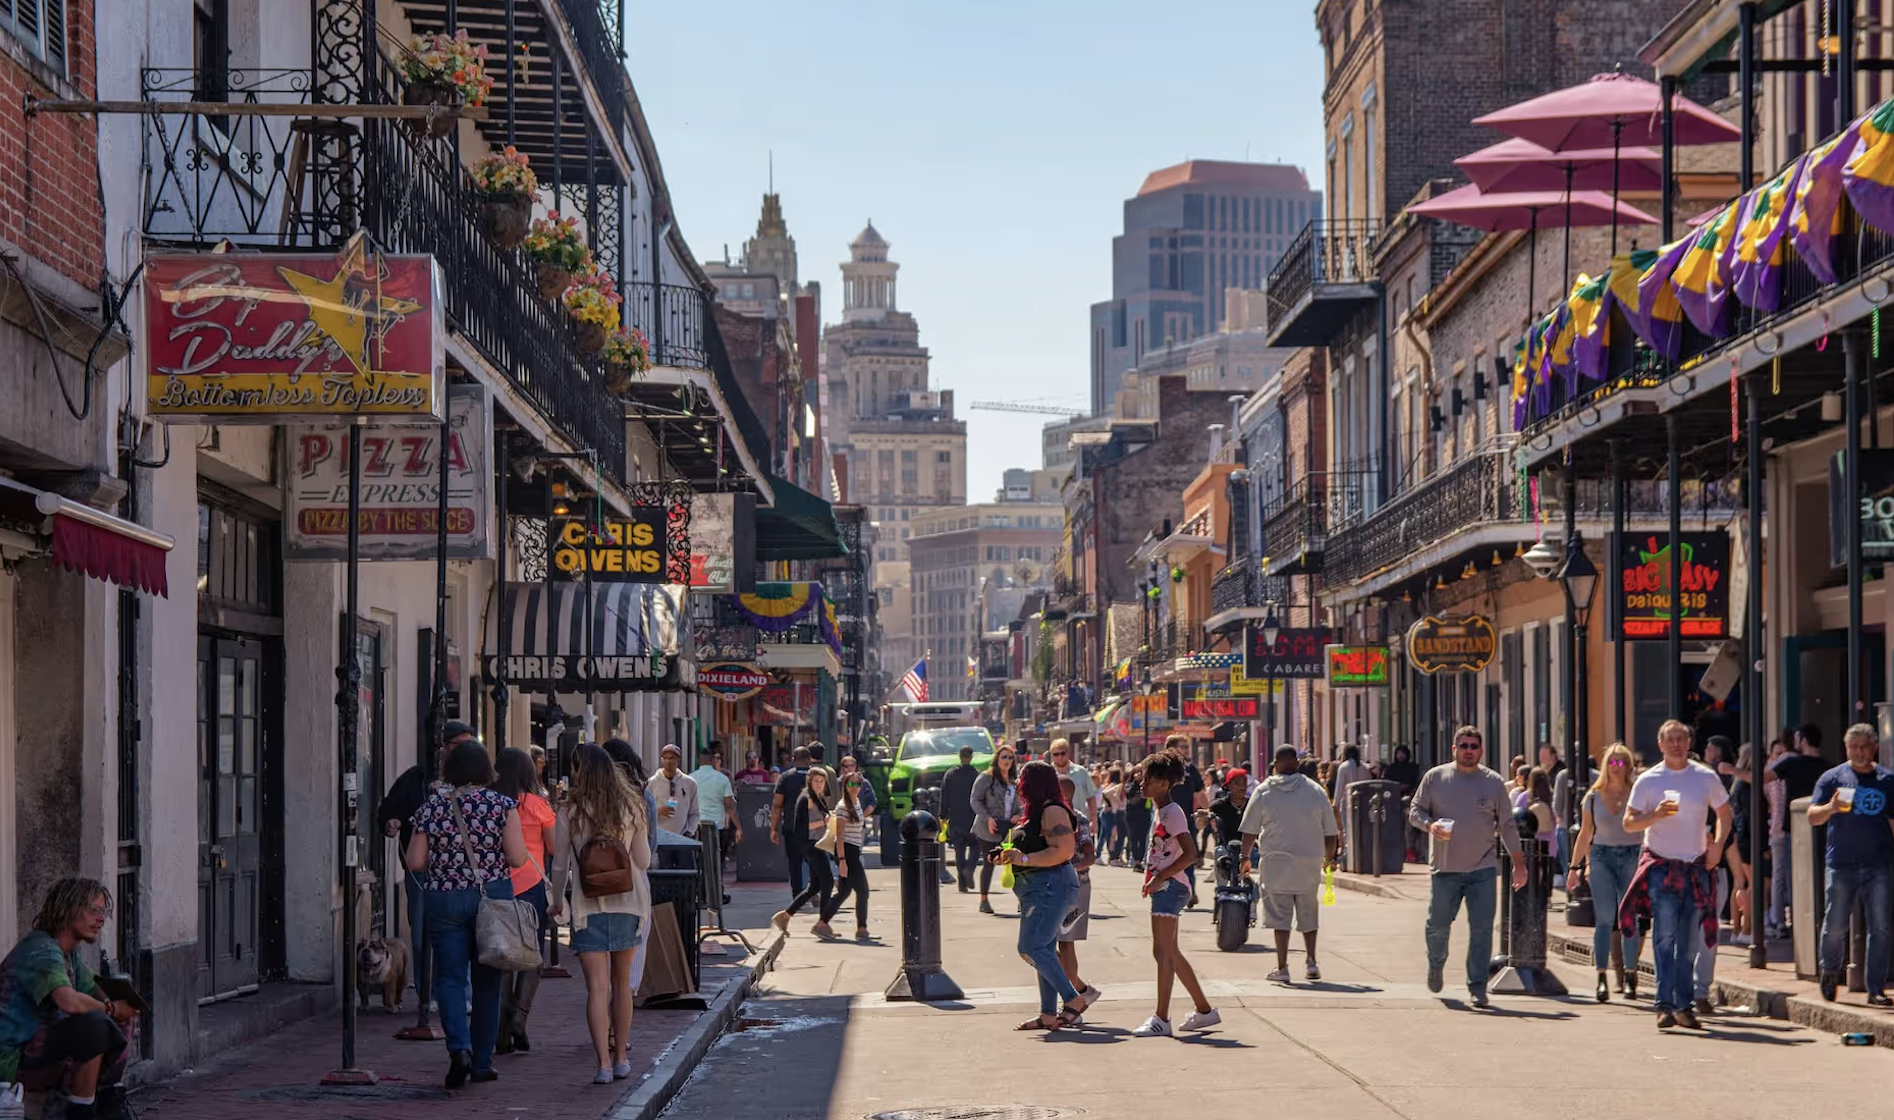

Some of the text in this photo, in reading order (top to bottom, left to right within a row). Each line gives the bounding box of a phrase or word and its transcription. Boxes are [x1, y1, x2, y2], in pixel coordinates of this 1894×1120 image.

[156, 320, 344, 384] Daddy's
[158, 377, 427, 411] Bottomless Topless
[299, 432, 474, 479] PIZZA
[385, 511, 417, 531] THE
[421, 510, 469, 531] SLCE
[554, 549, 661, 573] OWENS
[1623, 561, 1661, 592] BIG
[489, 656, 567, 679] CHRIS
[577, 656, 668, 679] OWENS
[697, 673, 768, 686] DIXIELAND
